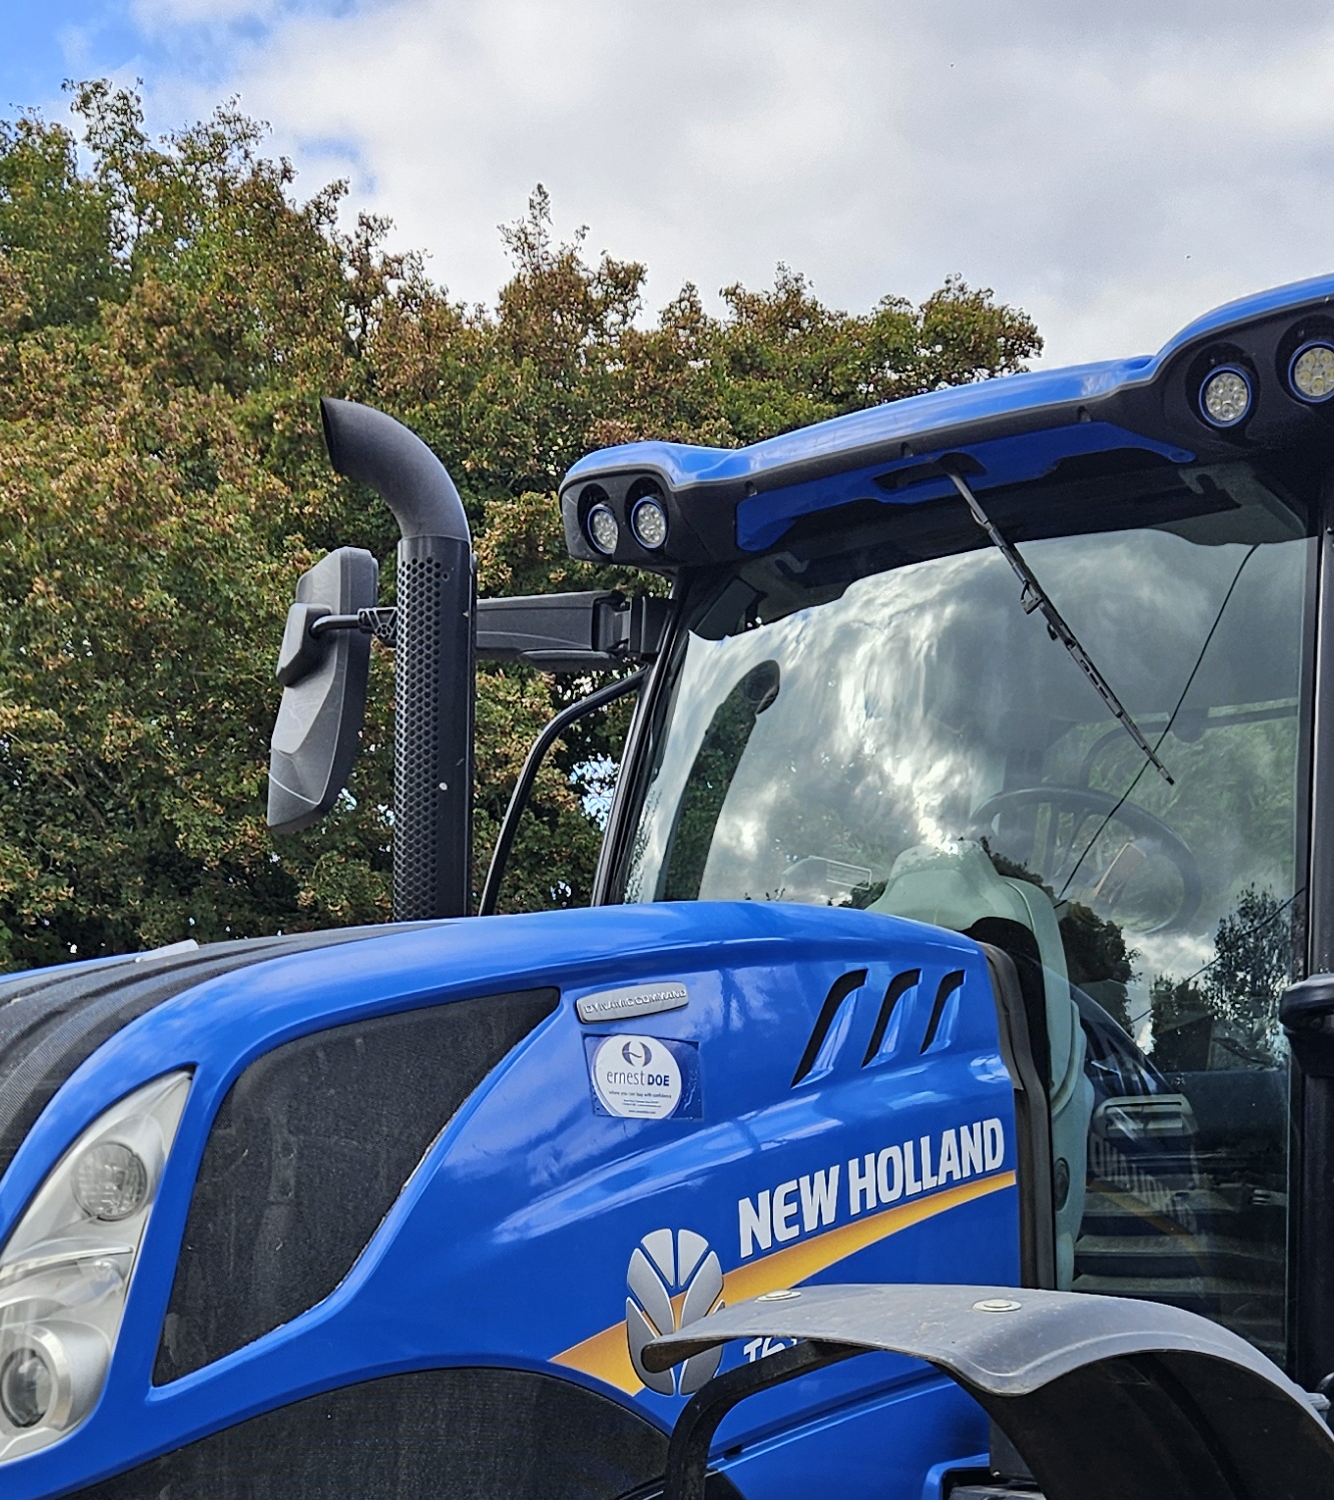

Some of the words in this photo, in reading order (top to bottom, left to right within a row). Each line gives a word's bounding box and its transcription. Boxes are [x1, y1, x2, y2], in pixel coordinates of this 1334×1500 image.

[635, 989, 686, 1006] COMMAND
[607, 1071, 644, 1086] ernest
[647, 1074, 670, 1087] DOE
[738, 1165, 839, 1258] NEW
[848, 1117, 1004, 1214] HOLLAND
